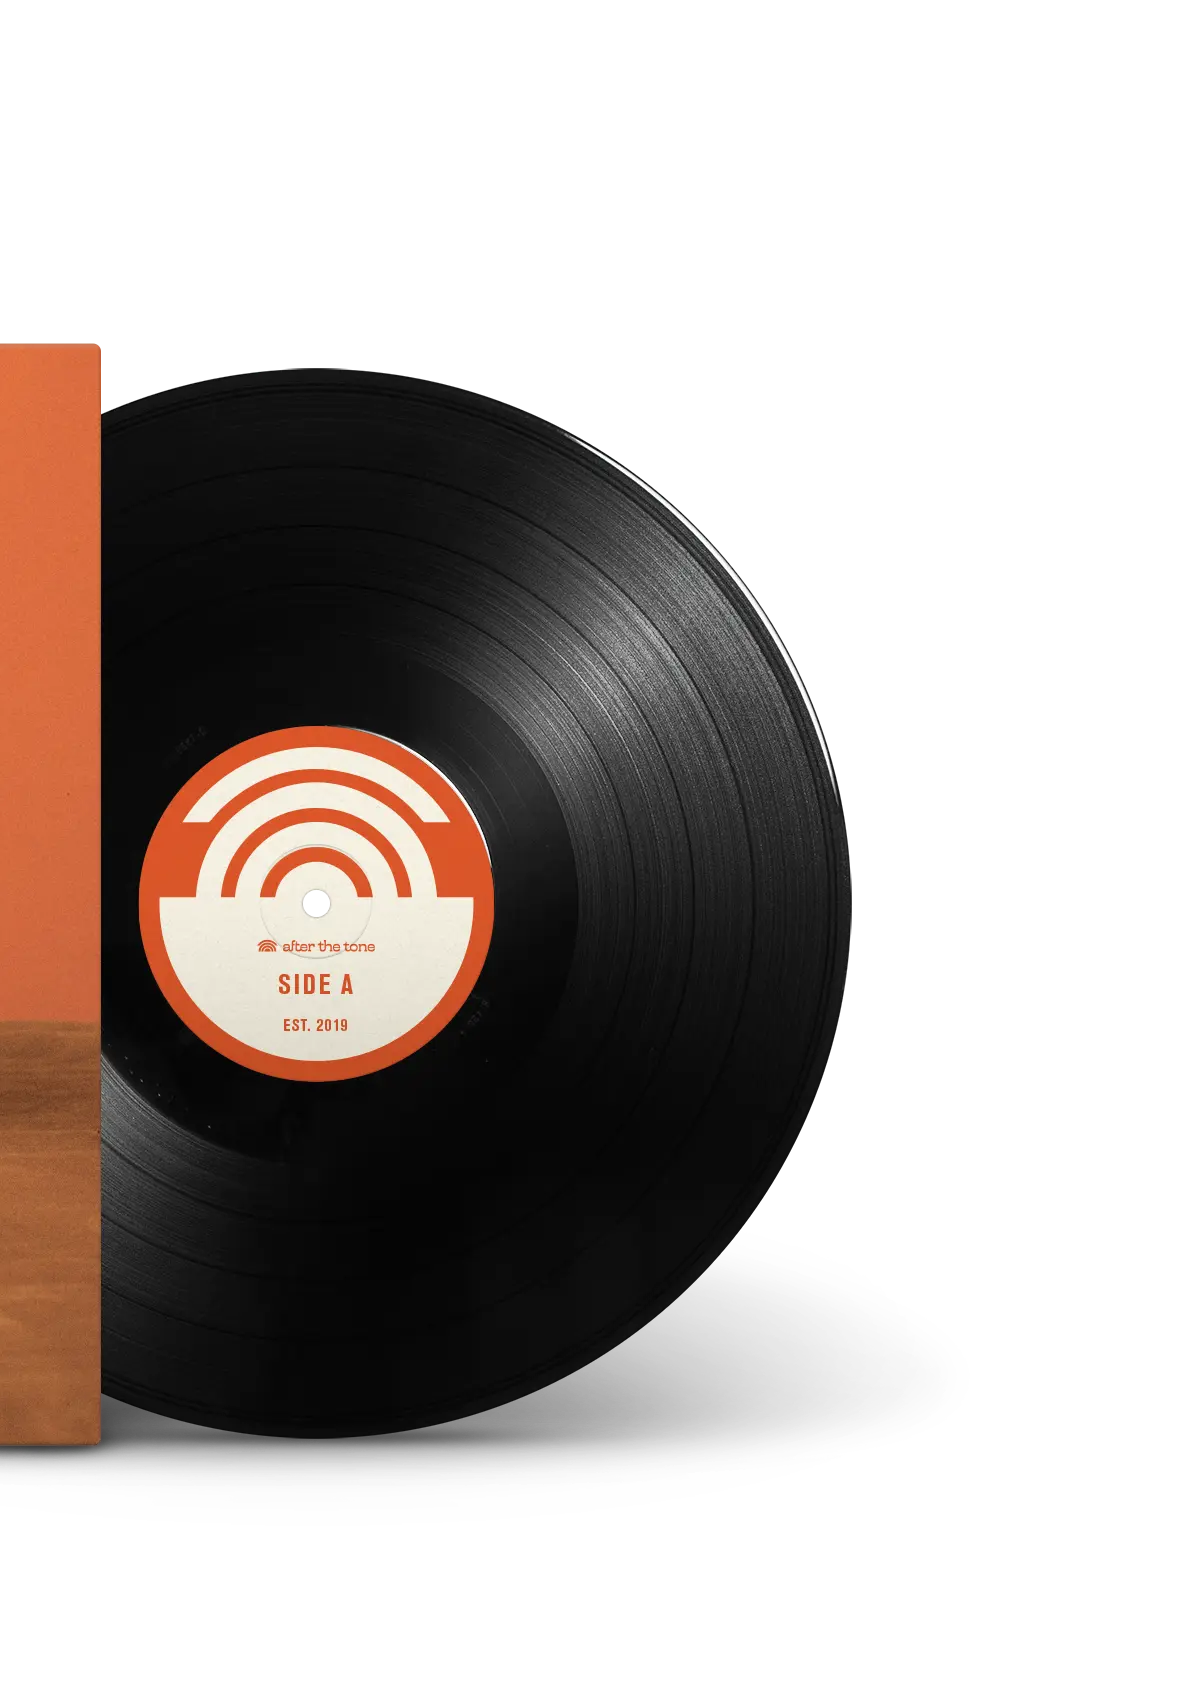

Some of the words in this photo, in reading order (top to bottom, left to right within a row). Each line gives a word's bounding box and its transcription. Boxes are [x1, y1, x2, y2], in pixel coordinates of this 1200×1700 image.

[282, 939, 316, 952] after
[317, 939, 341, 952] the
[342, 941, 376, 952] tone
[278, 973, 331, 995] SIDE
[340, 973, 354, 995] A
[283, 1018, 311, 1032] EST.
[316, 1018, 348, 1032] 2019
